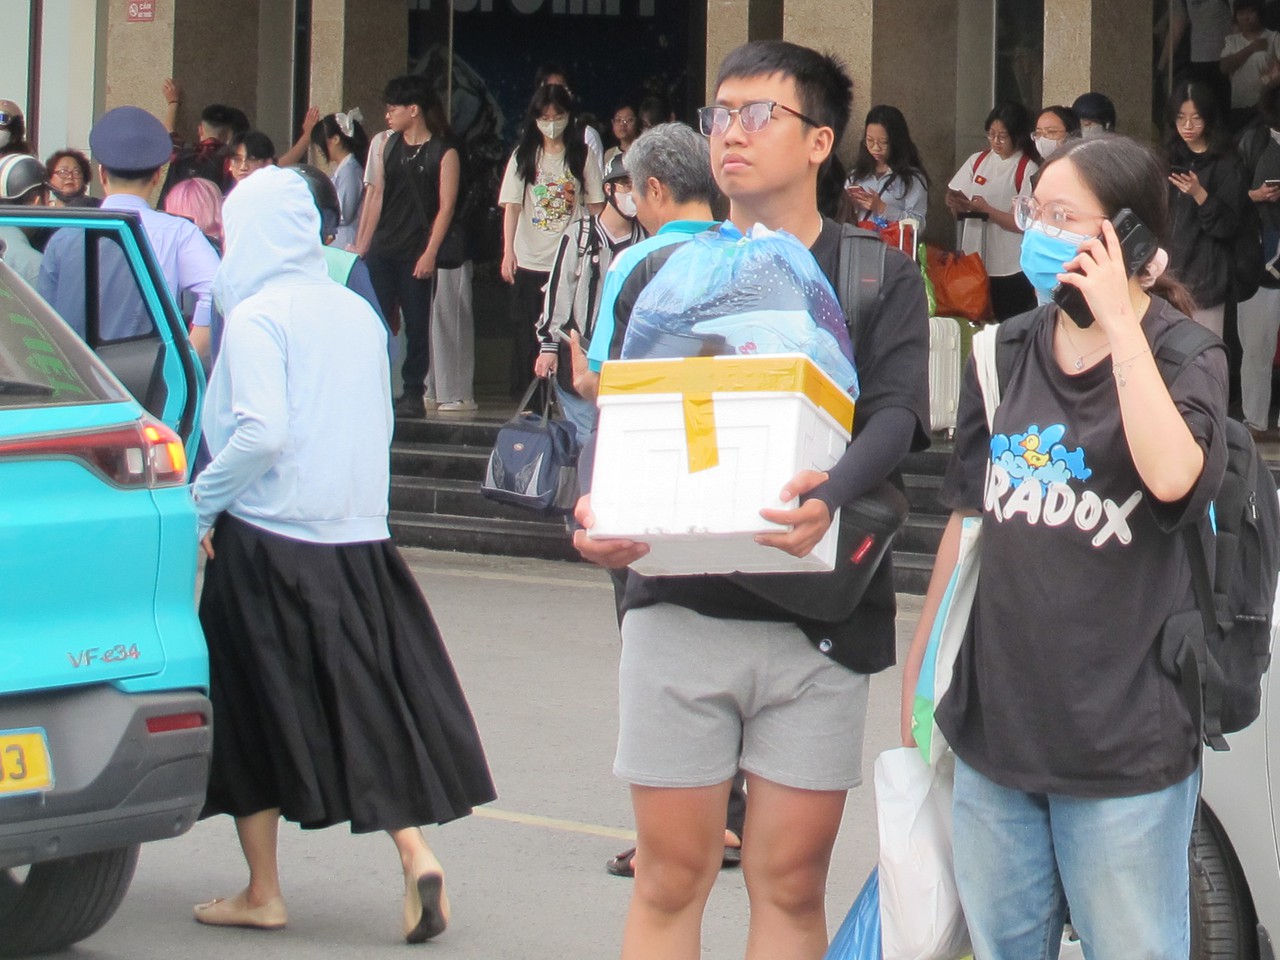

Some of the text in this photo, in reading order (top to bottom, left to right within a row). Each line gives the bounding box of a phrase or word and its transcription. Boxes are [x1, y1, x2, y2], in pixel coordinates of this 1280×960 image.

[66, 642, 141, 669] VF e34
[0, 742, 28, 782] 3
